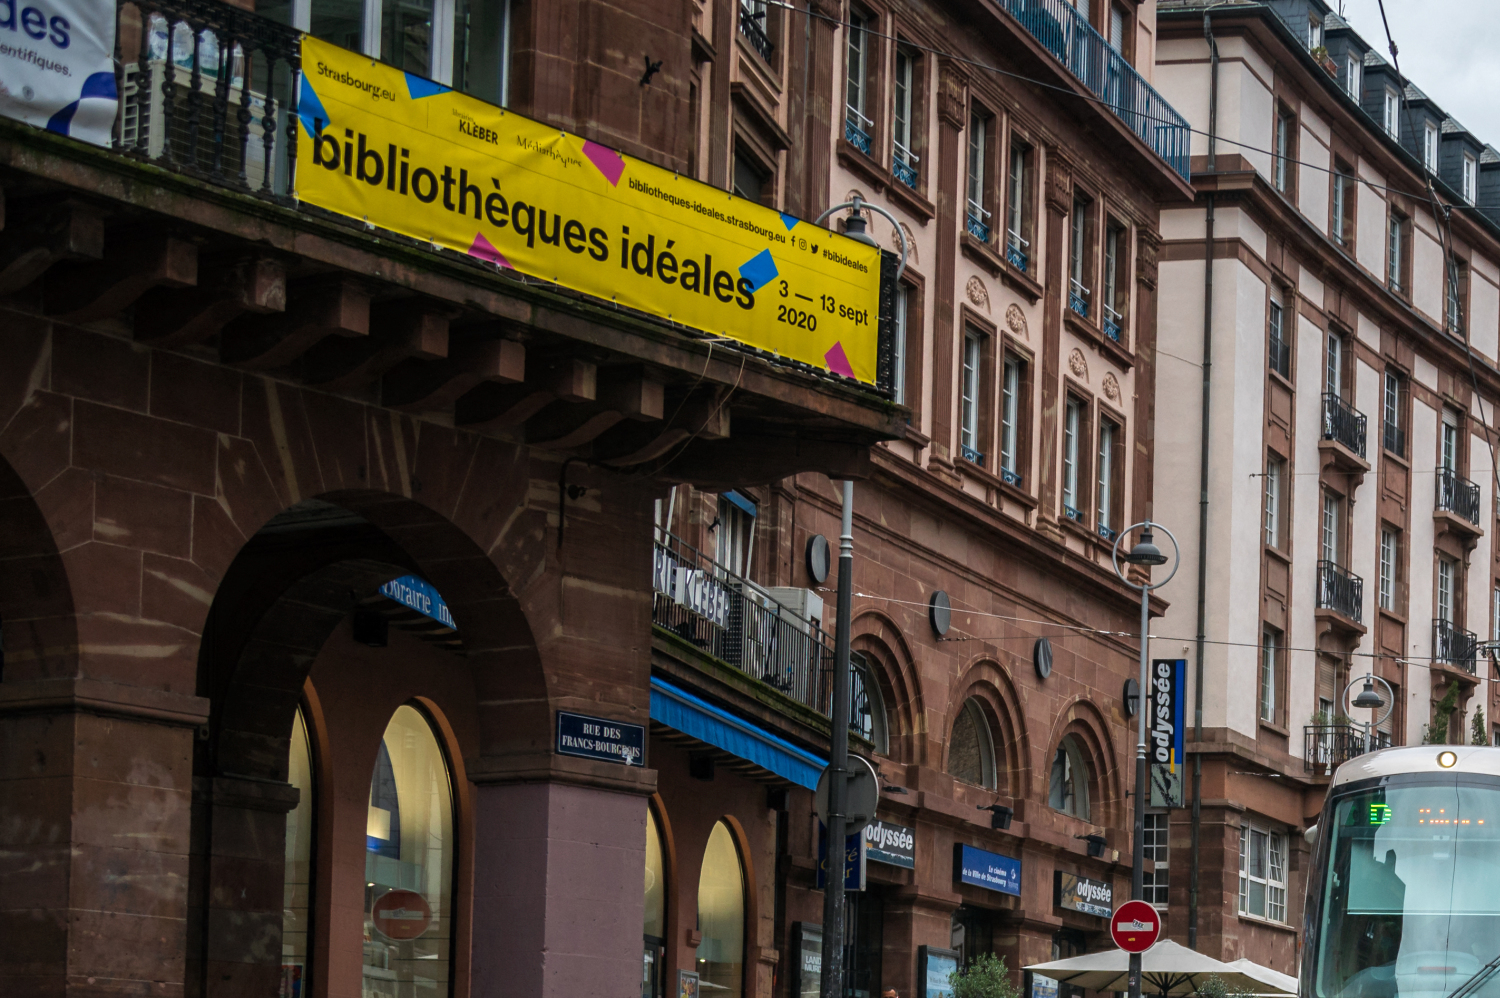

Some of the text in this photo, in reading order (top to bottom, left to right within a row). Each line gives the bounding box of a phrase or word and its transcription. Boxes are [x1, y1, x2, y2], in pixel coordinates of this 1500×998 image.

[317, 61, 396, 102] Strasbourg.eu
[515, 134, 583, 169] Médiathèques
[312, 117, 756, 311] bibliothèques idéales
[628, 177, 786, 244] bibliotheques-ideales.strasbourg.eu
[822, 249, 869, 274] #bibideales
[776, 304, 818, 333] 2020
[778, 279, 789, 299] 3
[819, 294, 836, 315] 13
[838, 303, 869, 327] sept
[1151, 662, 1175, 763] odyssée
[583, 723, 621, 740] RUE DES
[1370, 803, 1392, 825] D
[866, 821, 914, 851] odyssée
[1077, 879, 1112, 902] odyssée
